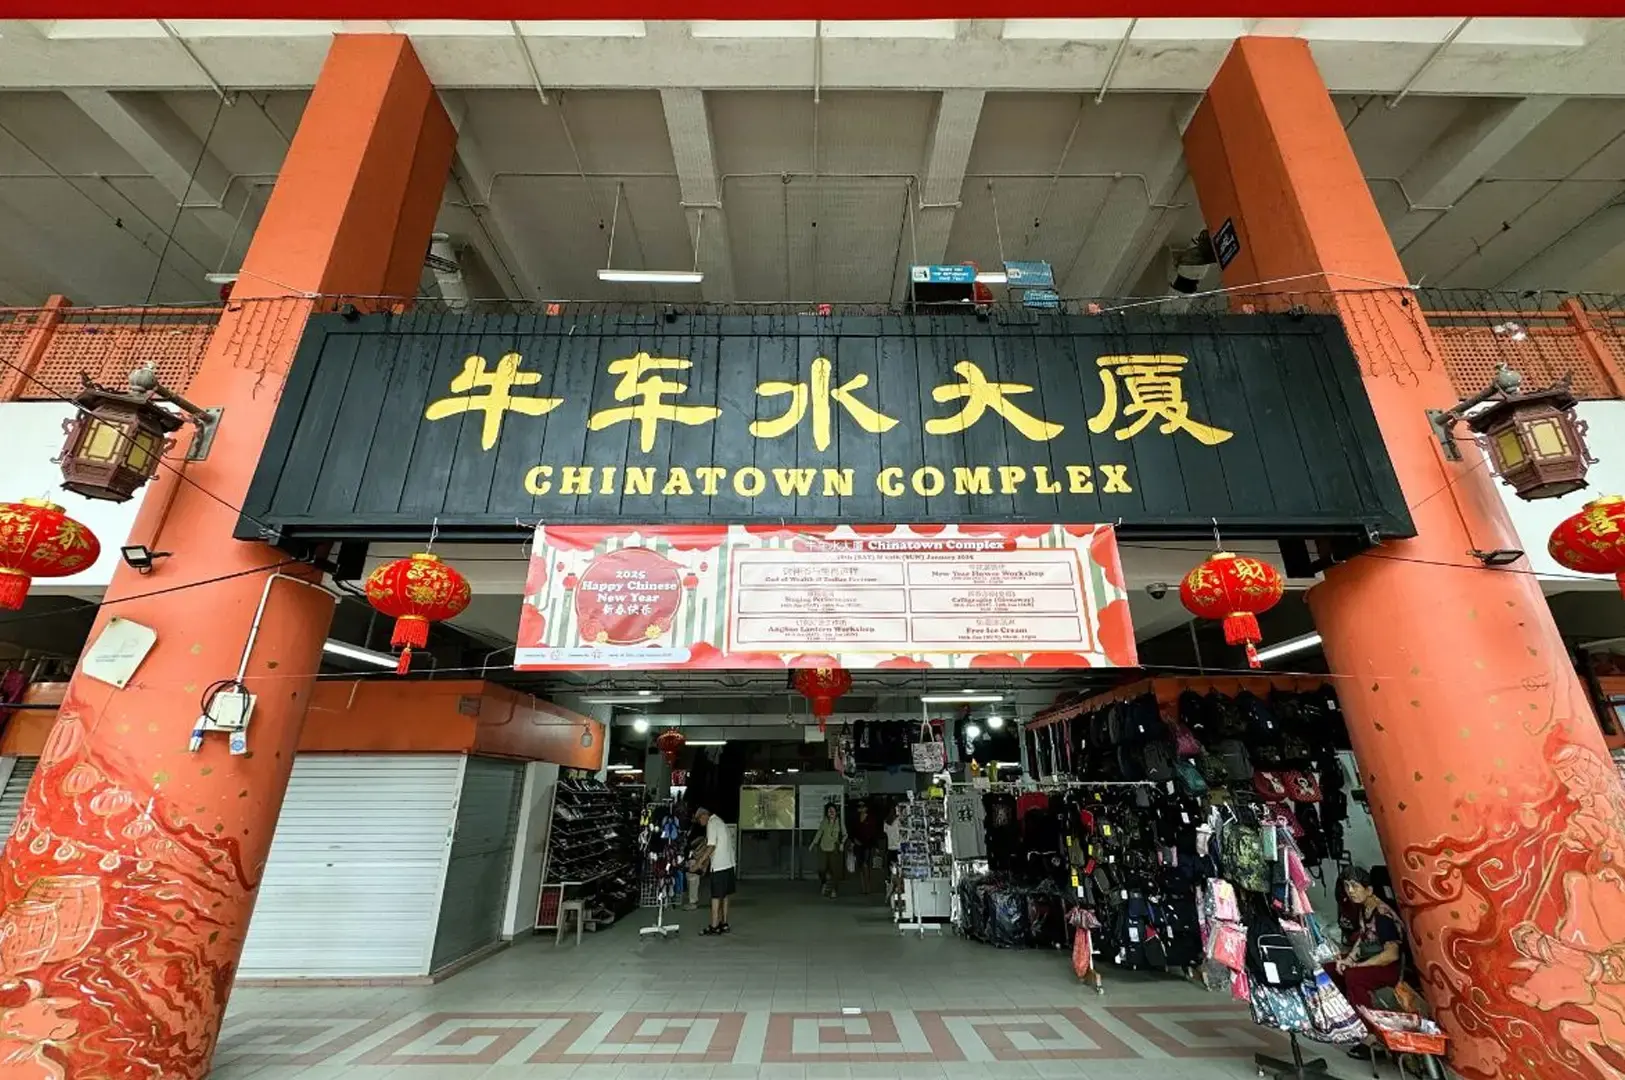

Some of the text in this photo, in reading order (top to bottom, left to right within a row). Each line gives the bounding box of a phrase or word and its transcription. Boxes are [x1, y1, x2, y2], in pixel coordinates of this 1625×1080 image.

[425, 353, 1234, 453] 牛车水大厦
[524, 464, 1133, 497] CHINATOWN COMPLEX
[867, 540, 943, 550] Chinatown
[946, 540, 1005, 551] Complex
[615, 570, 646, 579] 2025
[582, 581, 677, 591] Happy Chinese
[597, 593, 660, 602] New Year
